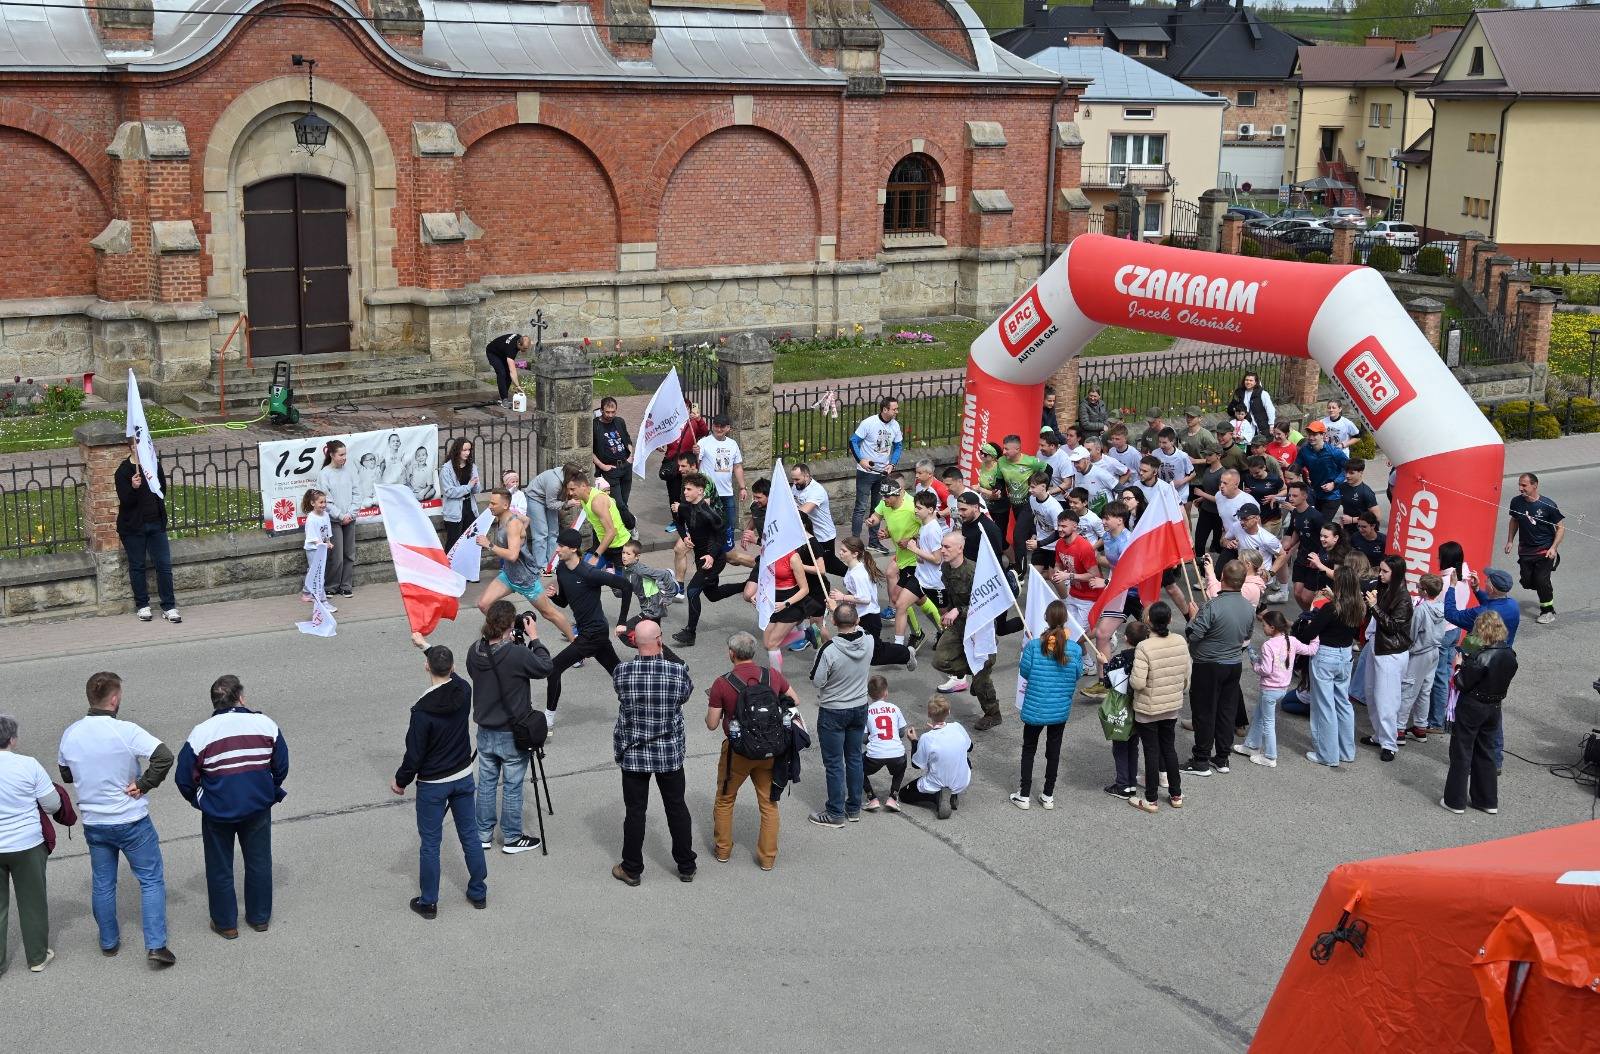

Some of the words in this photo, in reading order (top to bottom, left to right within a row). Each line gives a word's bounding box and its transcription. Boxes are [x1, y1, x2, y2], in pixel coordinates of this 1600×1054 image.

[1114, 264, 1260, 315] CZAKRAM
[1008, 305, 1032, 335] BRC
[1128, 300, 1171, 321] Jacek
[1177, 309, 1242, 333] Okoński
[1018, 346, 1036, 364] AUTO
[1034, 338, 1046, 349] NA
[1044, 325, 1059, 339] GAZ
[1353, 360, 1388, 402] BRC
[960, 393, 977, 487] AKRAM
[275, 446, 317, 478] 1,5
[875, 715, 894, 740] 9
